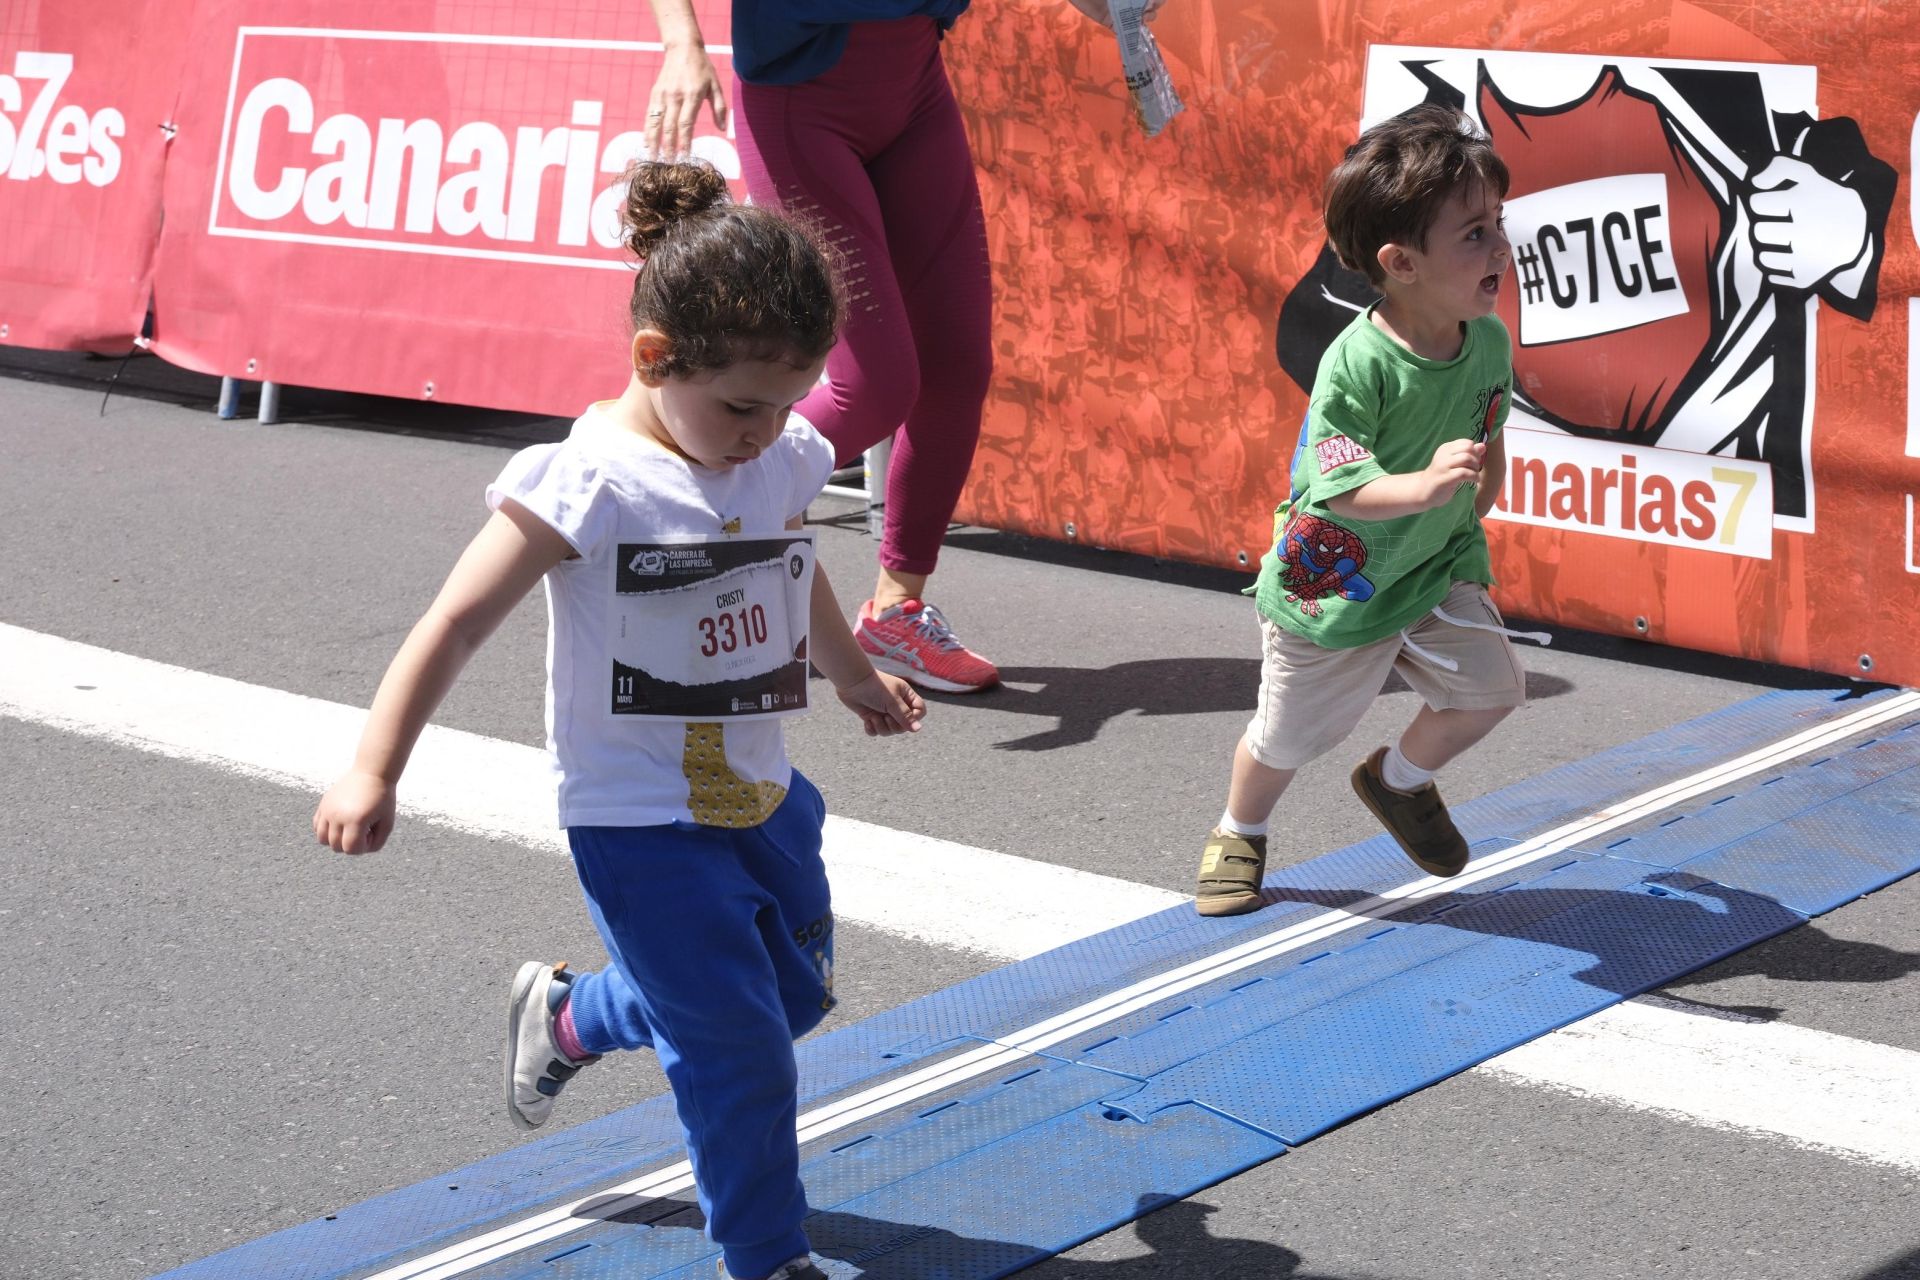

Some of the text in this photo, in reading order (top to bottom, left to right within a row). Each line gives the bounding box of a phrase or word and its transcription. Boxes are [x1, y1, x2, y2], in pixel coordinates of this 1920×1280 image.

[1517, 204, 1677, 309] #C7CE
[669, 549, 706, 560] CARRERA DE
[669, 558, 713, 569] LAS EMPRESAS
[716, 588, 745, 609] CRISTY
[698, 604, 768, 657] 3310
[618, 676, 632, 694] 11
[617, 695, 633, 704] MAYO
